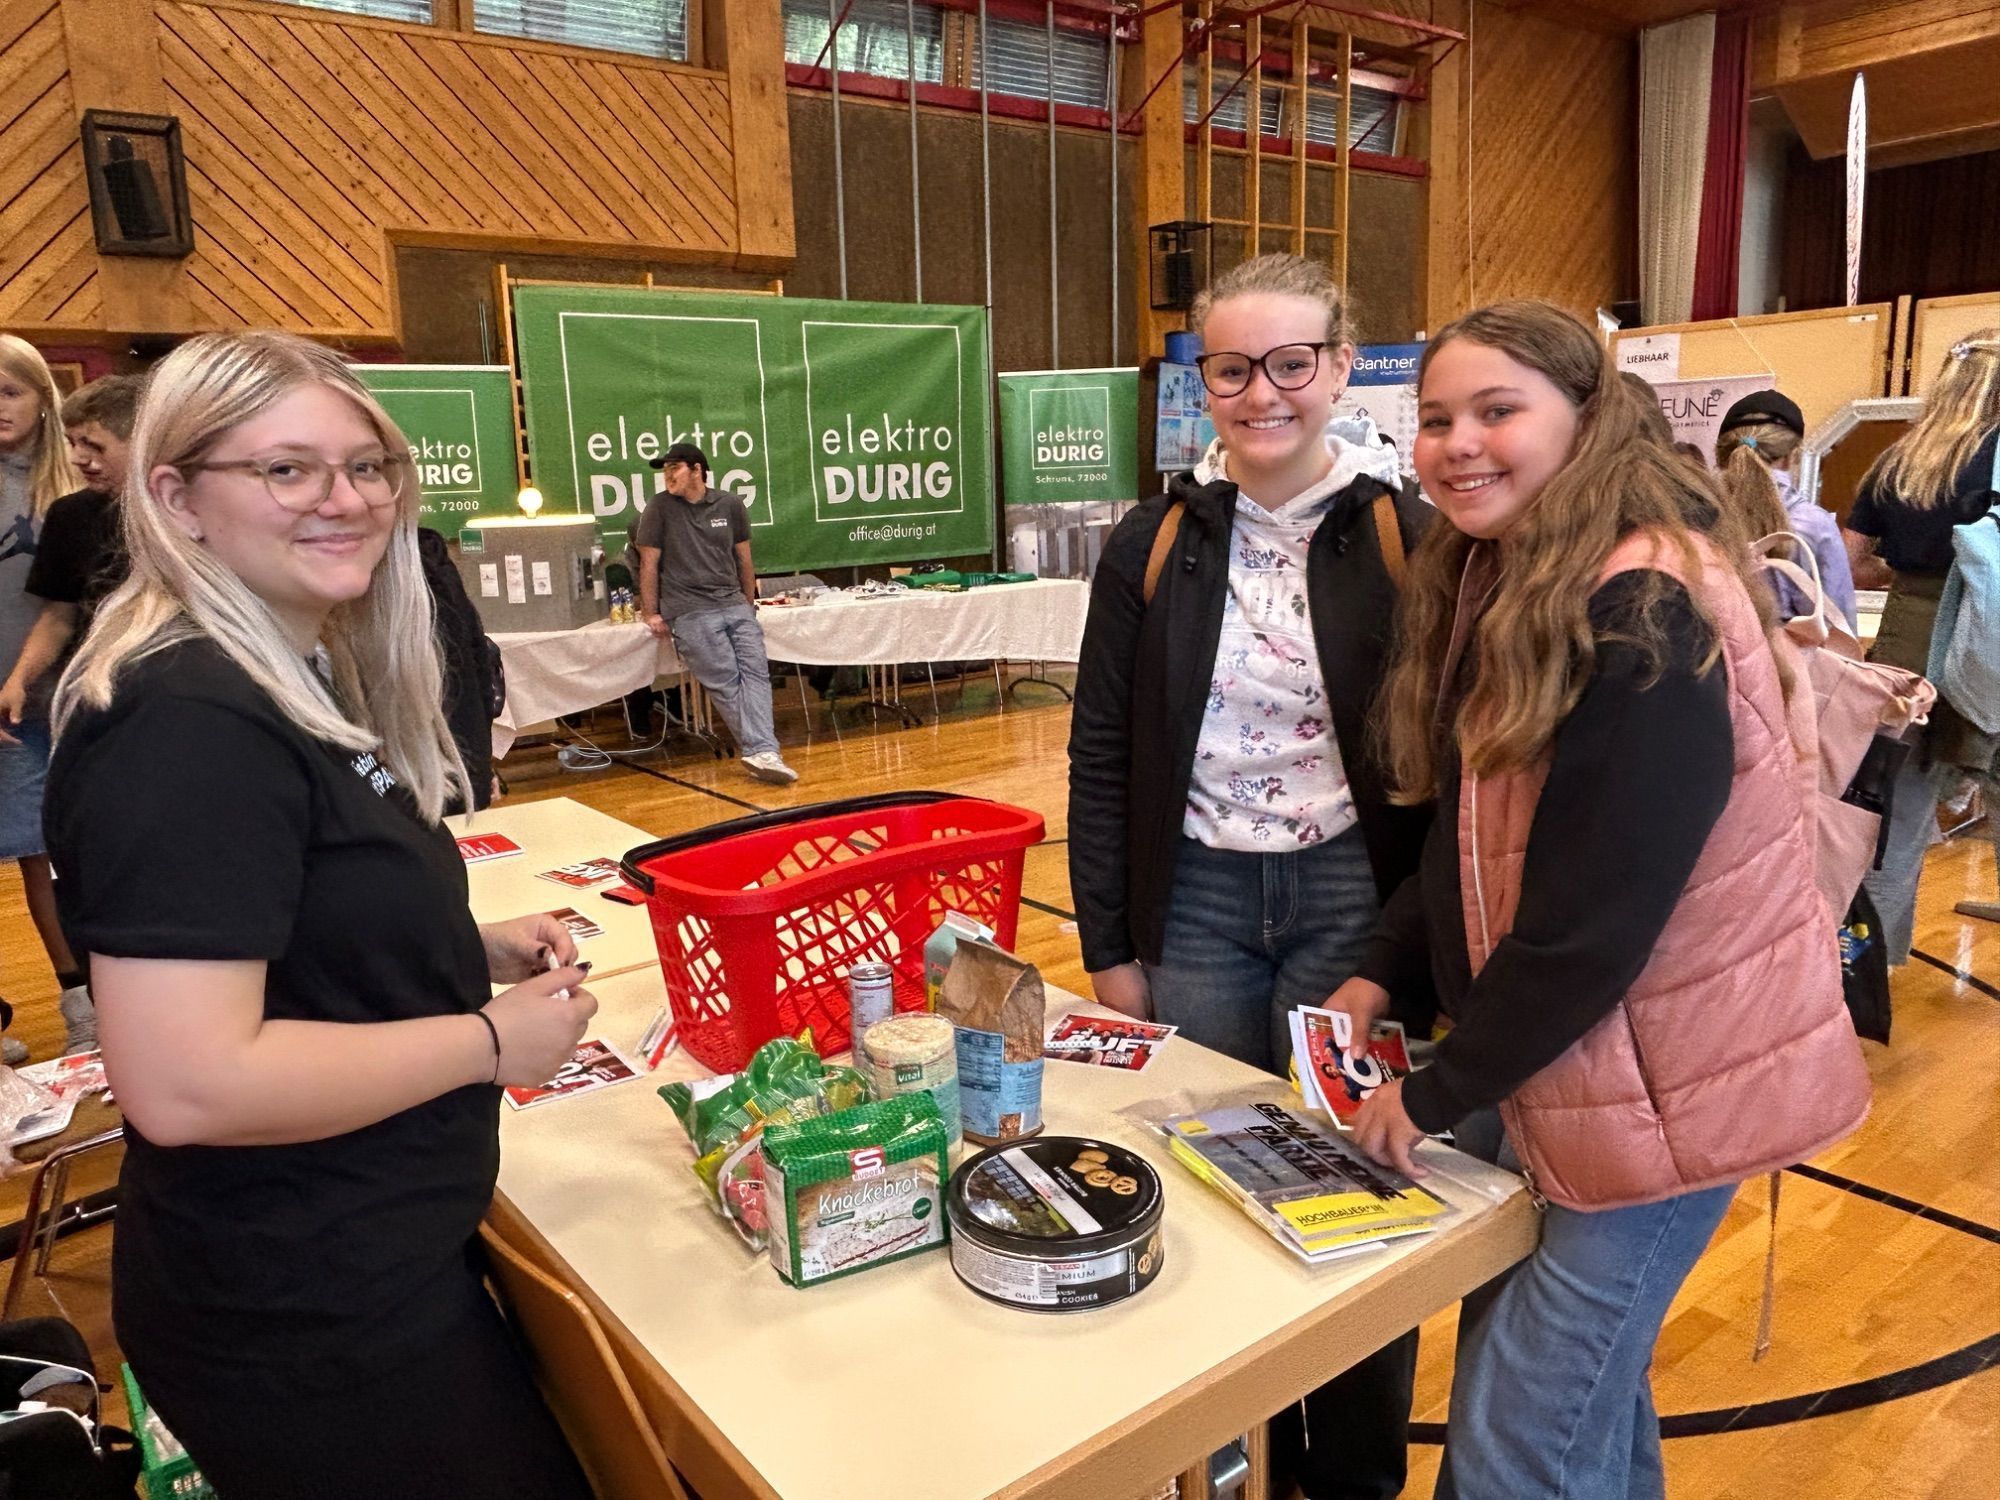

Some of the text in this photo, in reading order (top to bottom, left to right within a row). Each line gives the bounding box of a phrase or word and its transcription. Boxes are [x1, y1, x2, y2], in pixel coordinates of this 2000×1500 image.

[1353, 356, 1416, 370] Gantner
[1626, 352, 1670, 364] LIEBHAAR
[822, 412, 952, 455] elektro
[1037, 423, 1104, 443] elektro
[408, 436, 471, 459] ektro
[1037, 444, 1104, 463] DURIG
[823, 461, 953, 505] DURIG
[590, 469, 757, 517] DUG
[440, 500, 480, 512] 72000
[848, 523, 937, 542] office@durig.at
[898, 1070, 920, 1083] Vital
[820, 1168, 921, 1215] Knäckebrot
[1062, 1293, 1099, 1303] COOKIES
